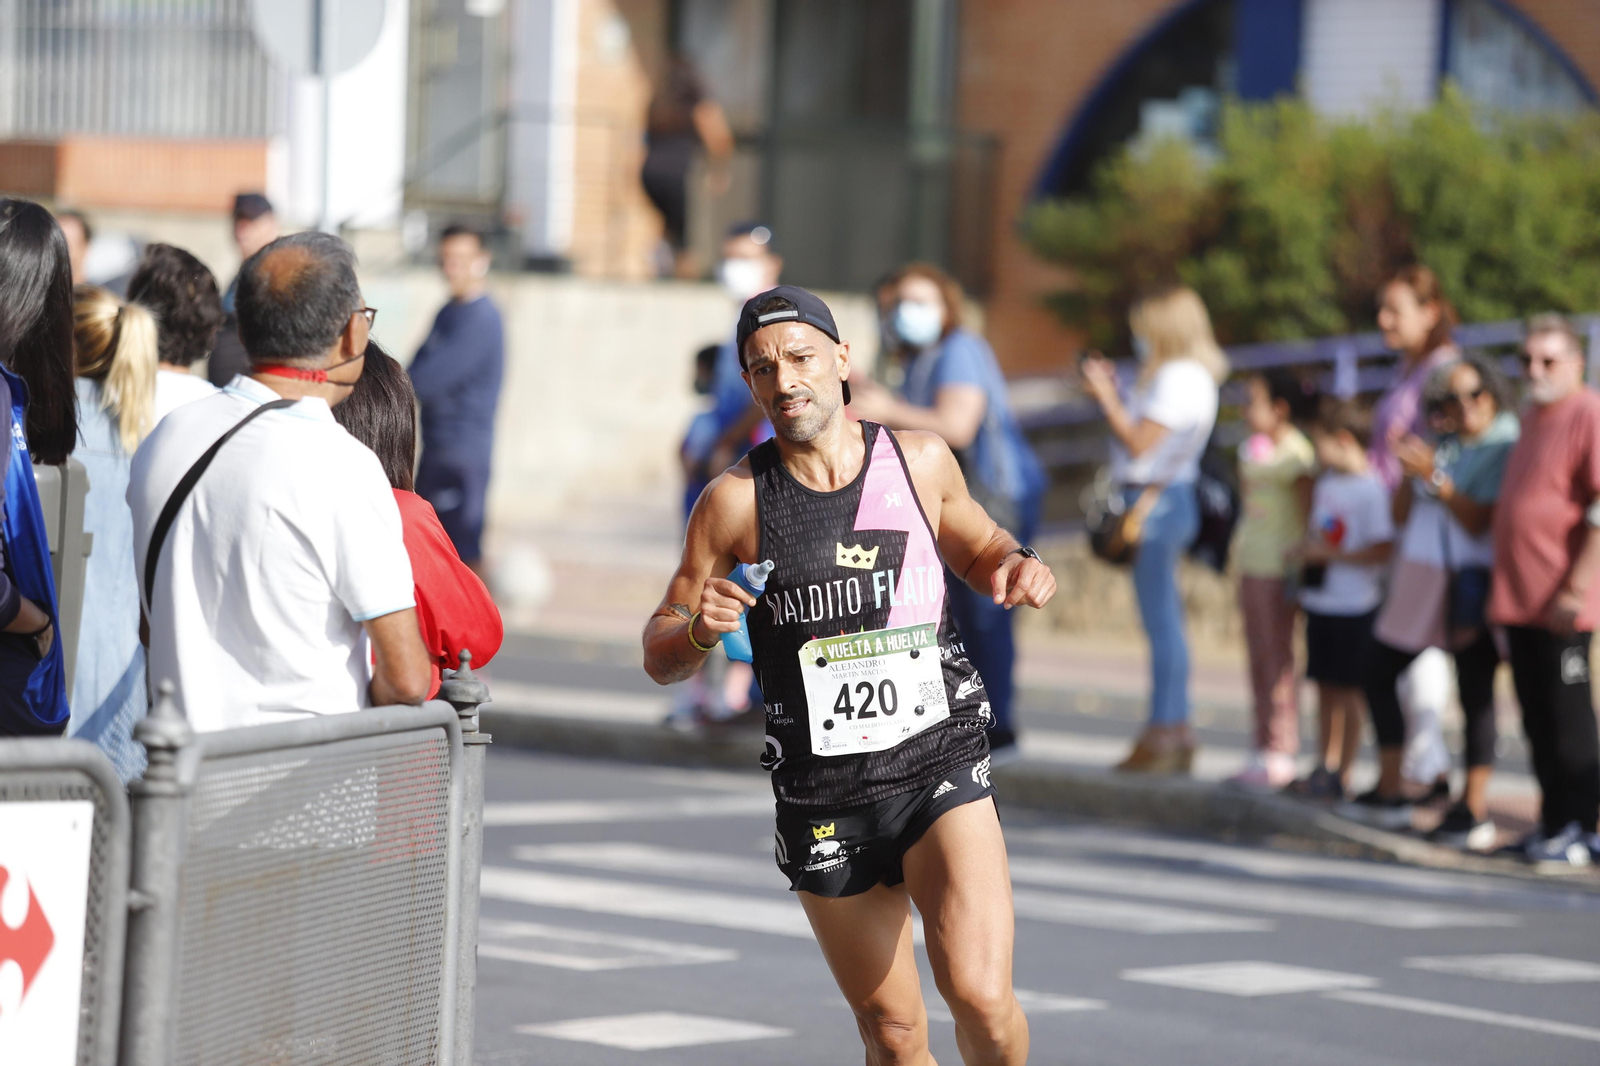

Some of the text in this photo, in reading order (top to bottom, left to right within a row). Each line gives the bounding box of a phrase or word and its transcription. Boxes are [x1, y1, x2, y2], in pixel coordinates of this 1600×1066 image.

[872, 565, 937, 609] FLATO
[809, 629, 929, 661] 34 VUELTA A HUELVA
[828, 658, 886, 673] ALEJANDRO
[831, 671, 860, 680] MARTIN
[833, 678, 898, 721] 420
